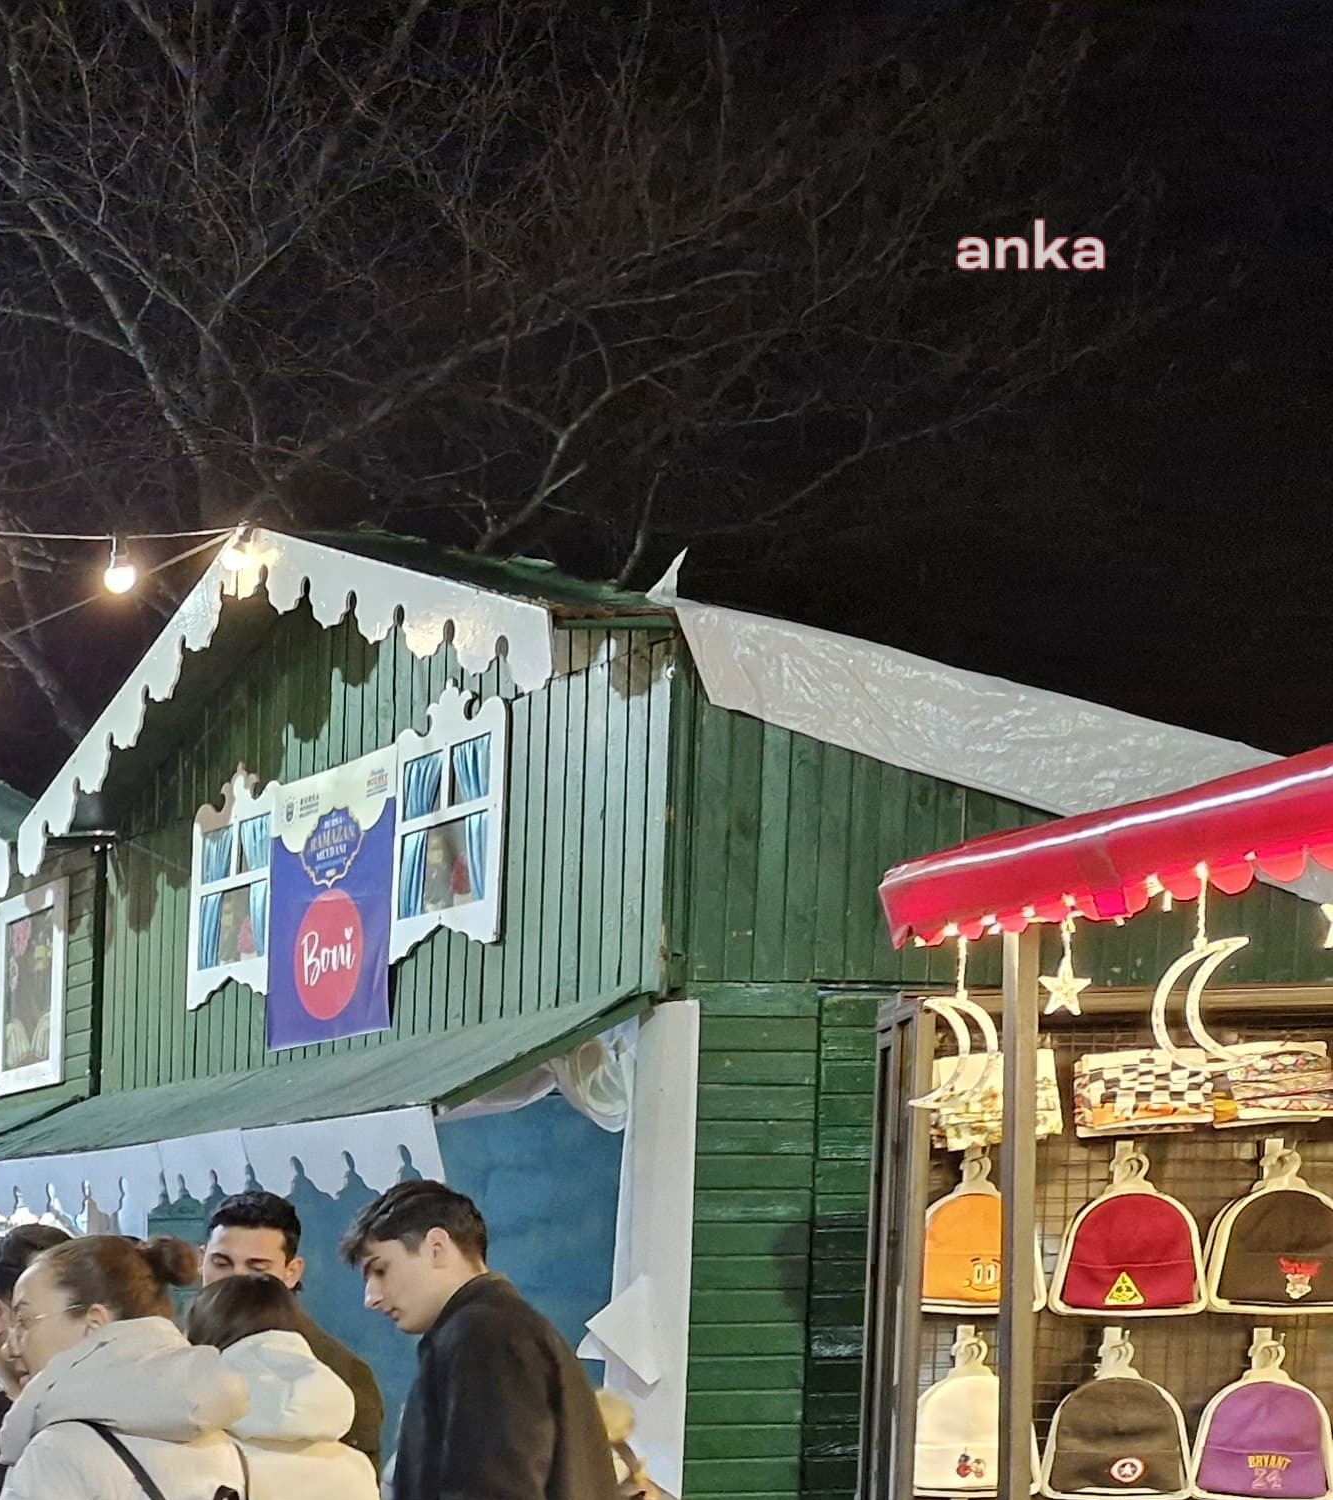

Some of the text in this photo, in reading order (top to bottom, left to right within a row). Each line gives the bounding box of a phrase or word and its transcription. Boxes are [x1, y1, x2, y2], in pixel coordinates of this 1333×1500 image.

[301, 926, 356, 986] Boni
[1247, 1454, 1292, 1471] BRYANT
[1251, 1468, 1282, 1489] 24
